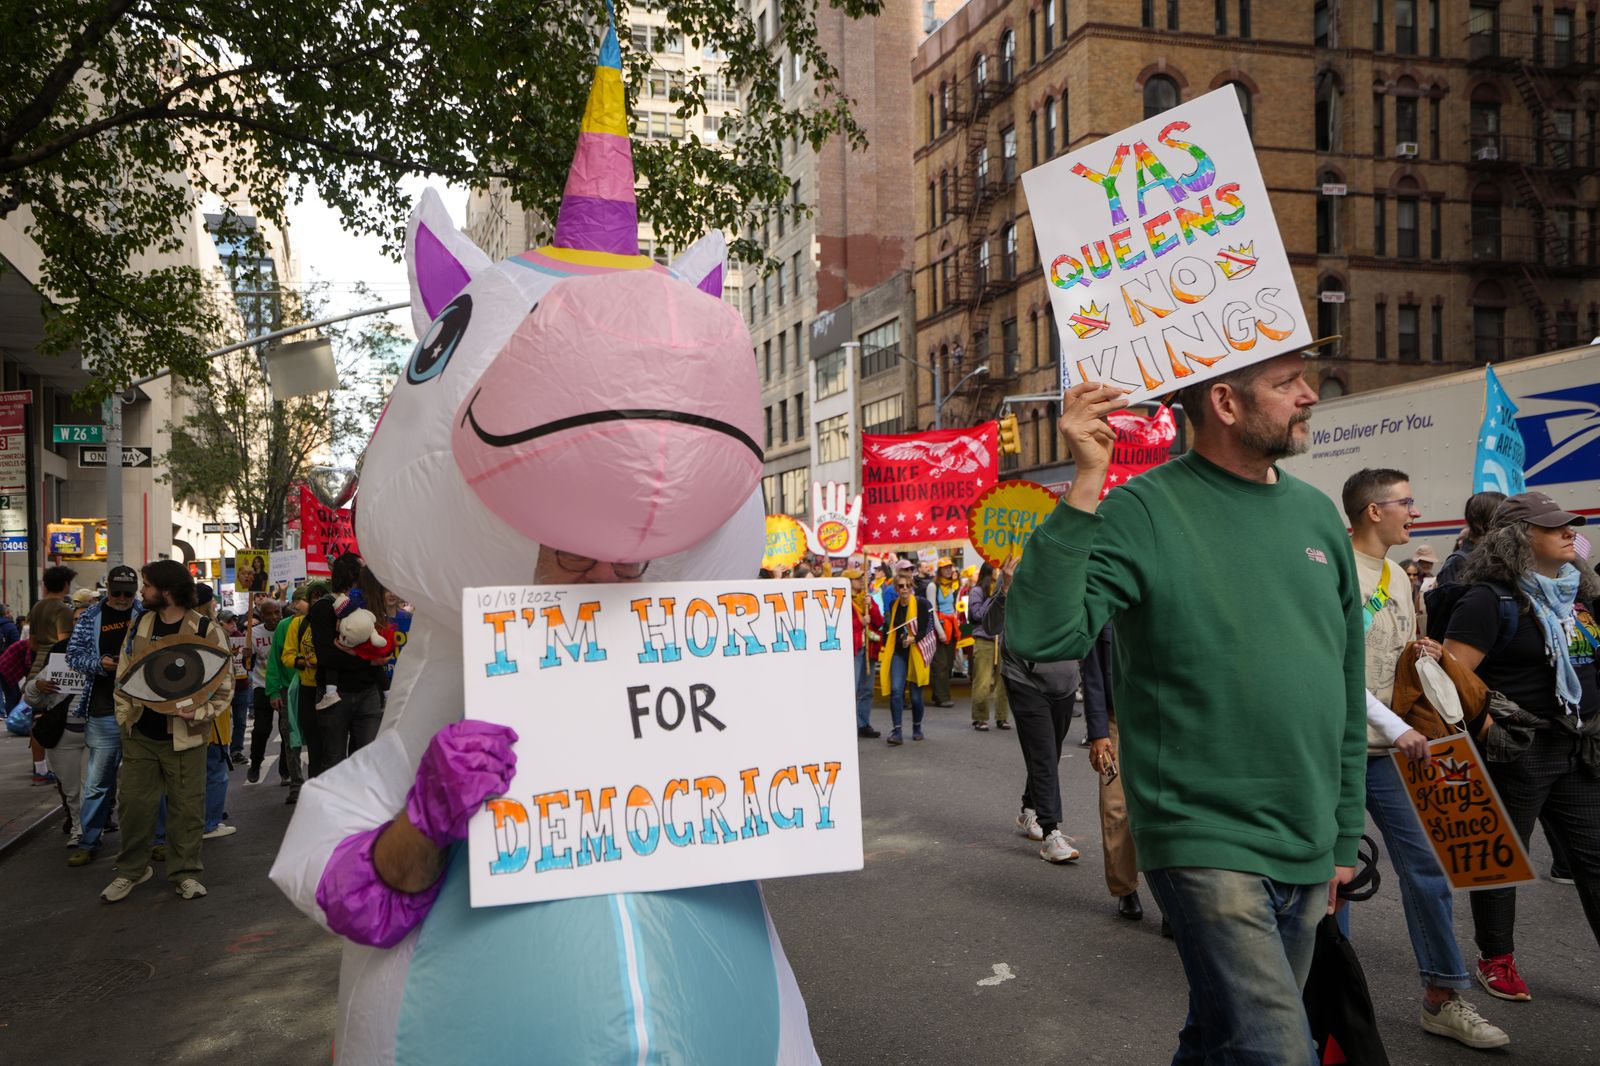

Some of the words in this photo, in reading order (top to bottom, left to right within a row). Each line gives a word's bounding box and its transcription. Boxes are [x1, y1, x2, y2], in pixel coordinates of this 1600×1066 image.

[1069, 121, 1216, 226] YAS
[1050, 183, 1246, 290] QUEENS
[1120, 256, 1216, 327] NO
[1076, 287, 1296, 392] KINGS
[60, 428, 69, 440] W
[73, 428, 87, 440] 26
[1312, 429, 1331, 445] We
[1333, 424, 1378, 442] Deliver
[1380, 418, 1403, 434] For
[1405, 414, 1434, 430] You.
[1312, 446, 1360, 459] www.usps.com
[867, 465, 920, 483] MAKE
[867, 480, 975, 505] BILLIONAIRES
[930, 505, 973, 522] PAY
[0, 542, 28, 550] 04048
[767, 542, 796, 557] OWER
[477, 589, 567, 607] 10/18/2025
[102, 621, 124, 632] DAILY
[483, 601, 607, 677] I'M
[630, 588, 846, 664] HORNY
[626, 683, 727, 740] FOR
[1407, 752, 1445, 784] No
[1416, 780, 1491, 815] Kings
[486, 761, 842, 876] DEMOCRACY
[1427, 807, 1498, 843] Since
[1447, 833, 1513, 874] 1776
